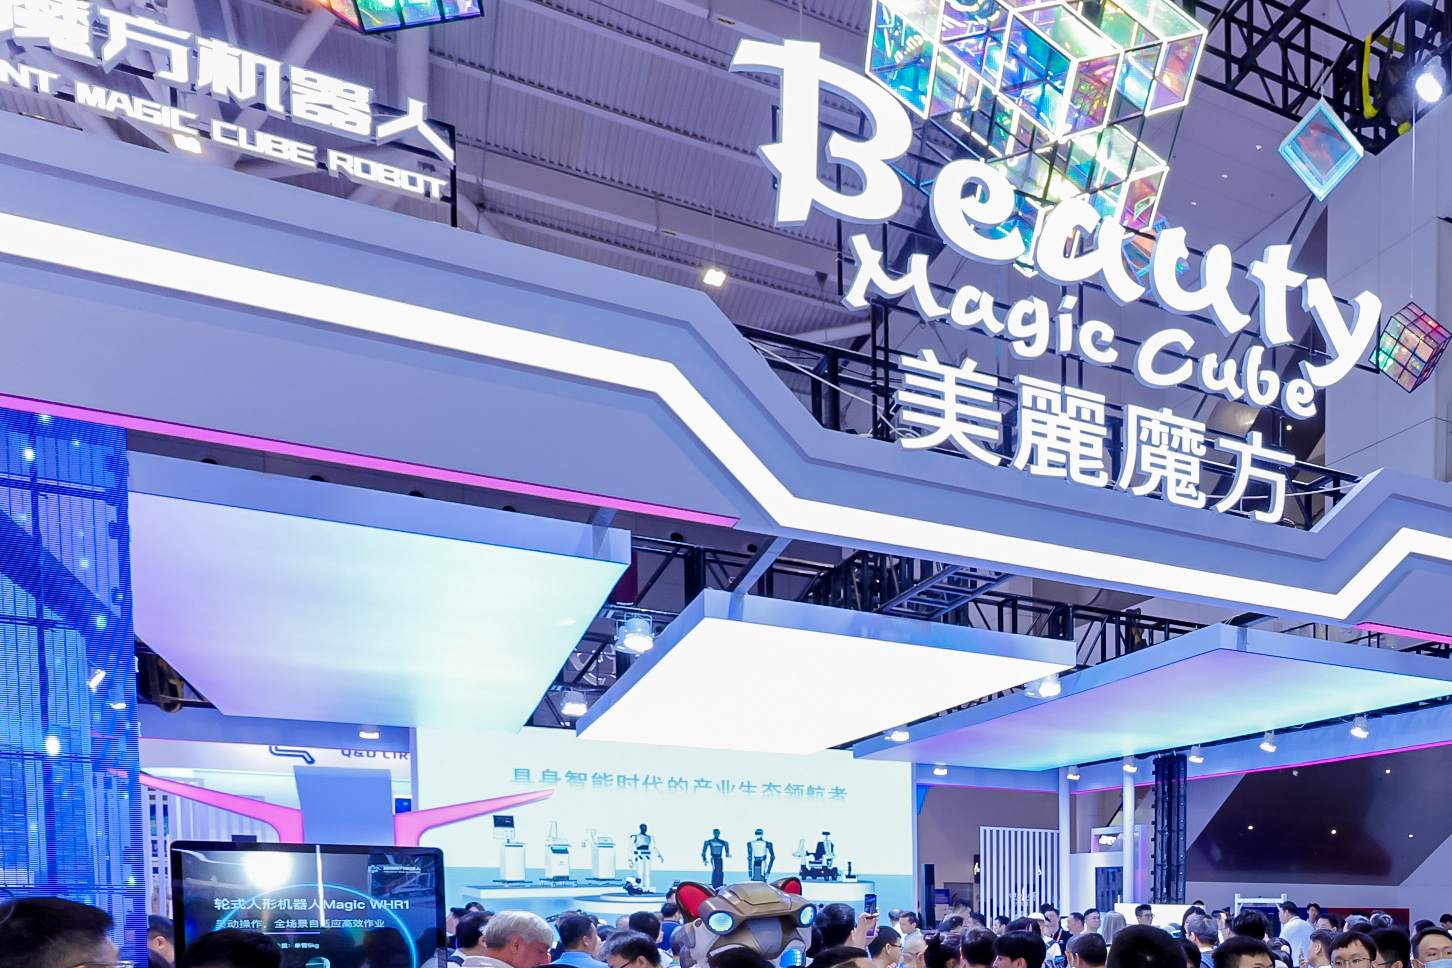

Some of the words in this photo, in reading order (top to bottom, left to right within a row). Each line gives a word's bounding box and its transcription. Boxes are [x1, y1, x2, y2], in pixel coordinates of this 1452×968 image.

[0, 0, 455, 162] 魔方机器人
[75, 80, 199, 135] MAGIC
[210, 119, 318, 168] CUBE
[328, 149, 448, 199] ROBOT
[728, 39, 1381, 390] Beauty
[841, 234, 1119, 359] Magic
[1137, 327, 1318, 420] Cube
[897, 349, 1296, 524] 美麗魔方
